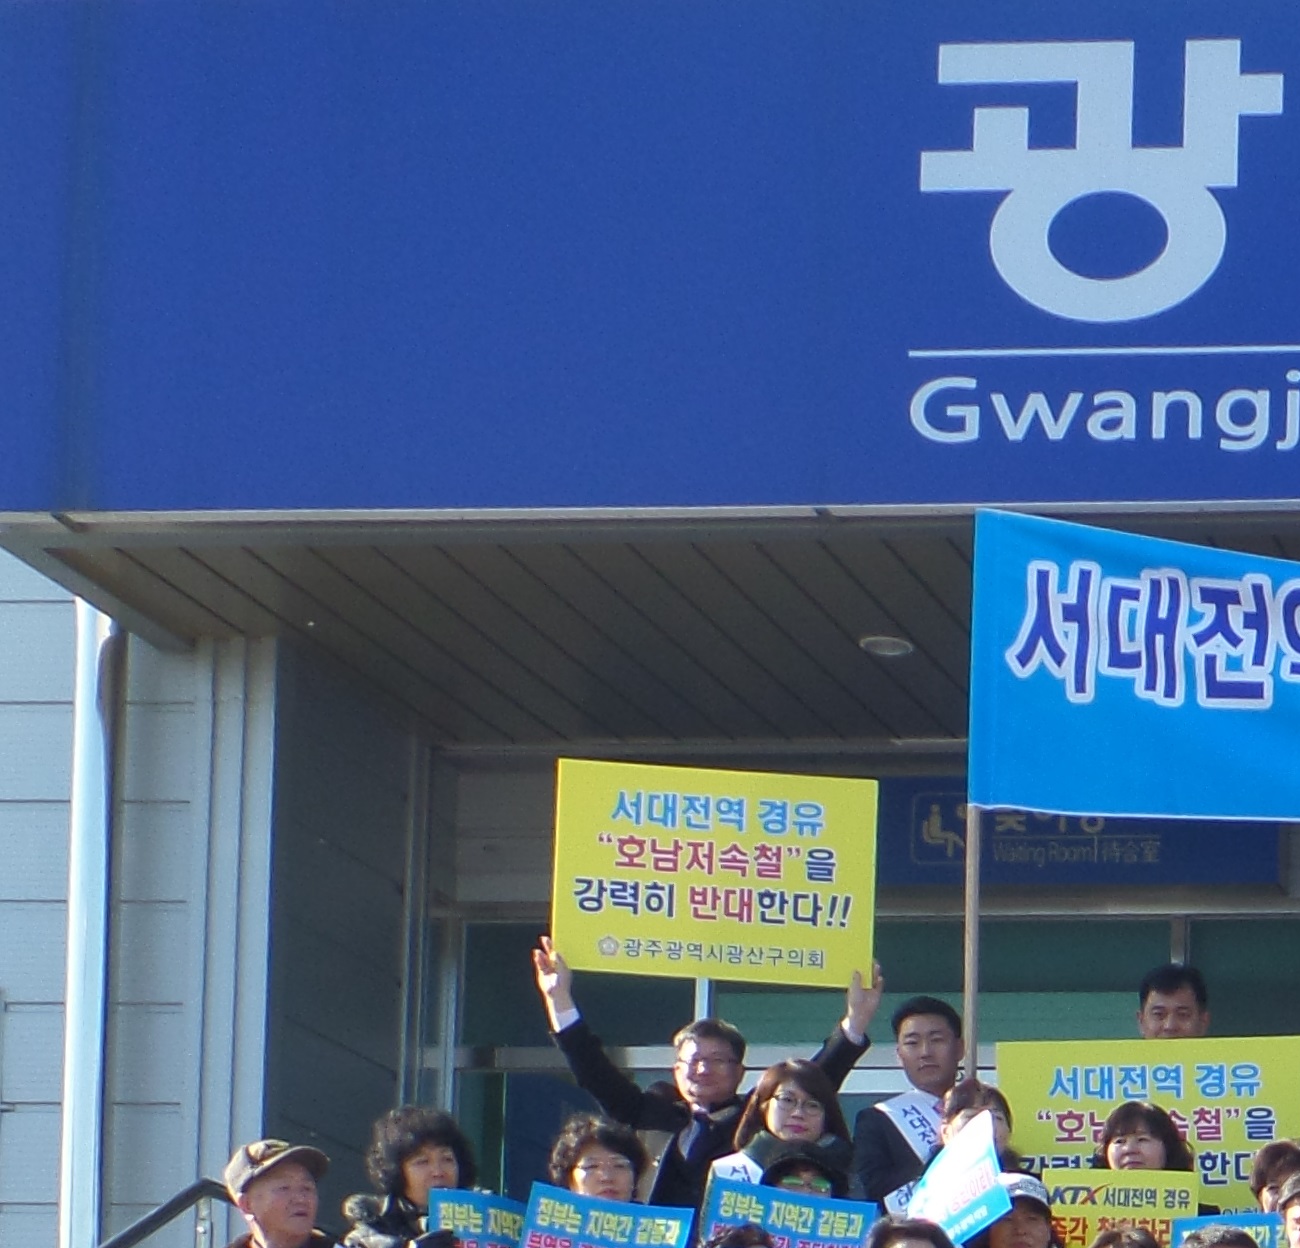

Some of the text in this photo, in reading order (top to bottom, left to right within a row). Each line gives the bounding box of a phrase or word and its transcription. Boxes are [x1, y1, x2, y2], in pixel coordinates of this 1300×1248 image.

[611, 788, 825, 838] 서대전역 경유
[574, 877, 851, 929] 강력히 반대한다!!
[622, 936, 825, 969] 광주광역시광산구의회
[1048, 1063, 1262, 1100] 서대전역 경유
[1103, 1186, 1158, 1206] 서대전역
[1164, 1188, 1191, 1207] 경유
[537, 1198, 681, 1246] 정부는 지역간 갈등과
